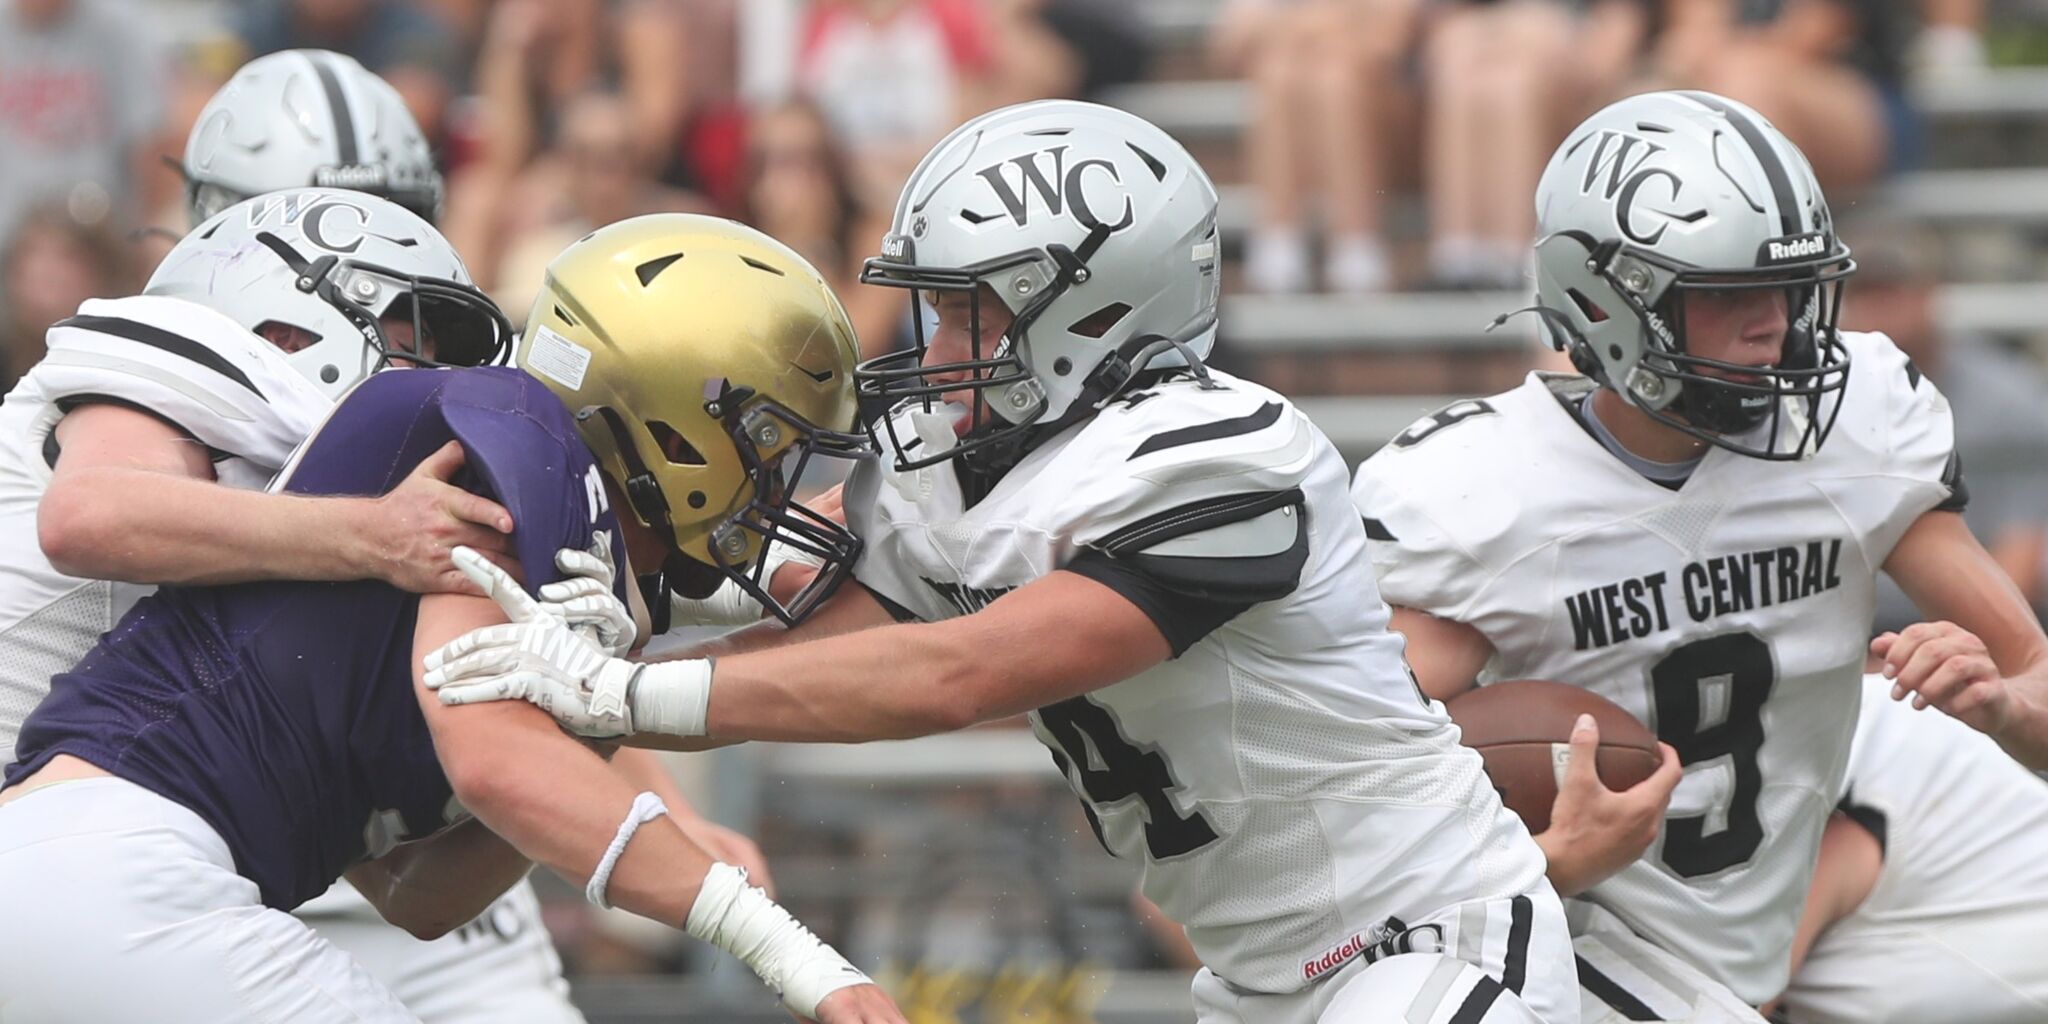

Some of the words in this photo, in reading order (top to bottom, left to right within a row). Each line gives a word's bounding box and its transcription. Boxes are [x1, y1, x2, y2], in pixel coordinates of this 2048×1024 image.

[247, 194, 374, 256] WC
[974, 143, 1136, 236] WC
[1581, 129, 1684, 247] WC
[1768, 235, 1825, 260] Riddell
[1564, 570, 1671, 651] WEST
[1681, 538, 1843, 623] CENTRAL
[1033, 694, 1222, 861] 4
[1648, 629, 1777, 880] 9
[1303, 933, 1367, 979] Riddell
